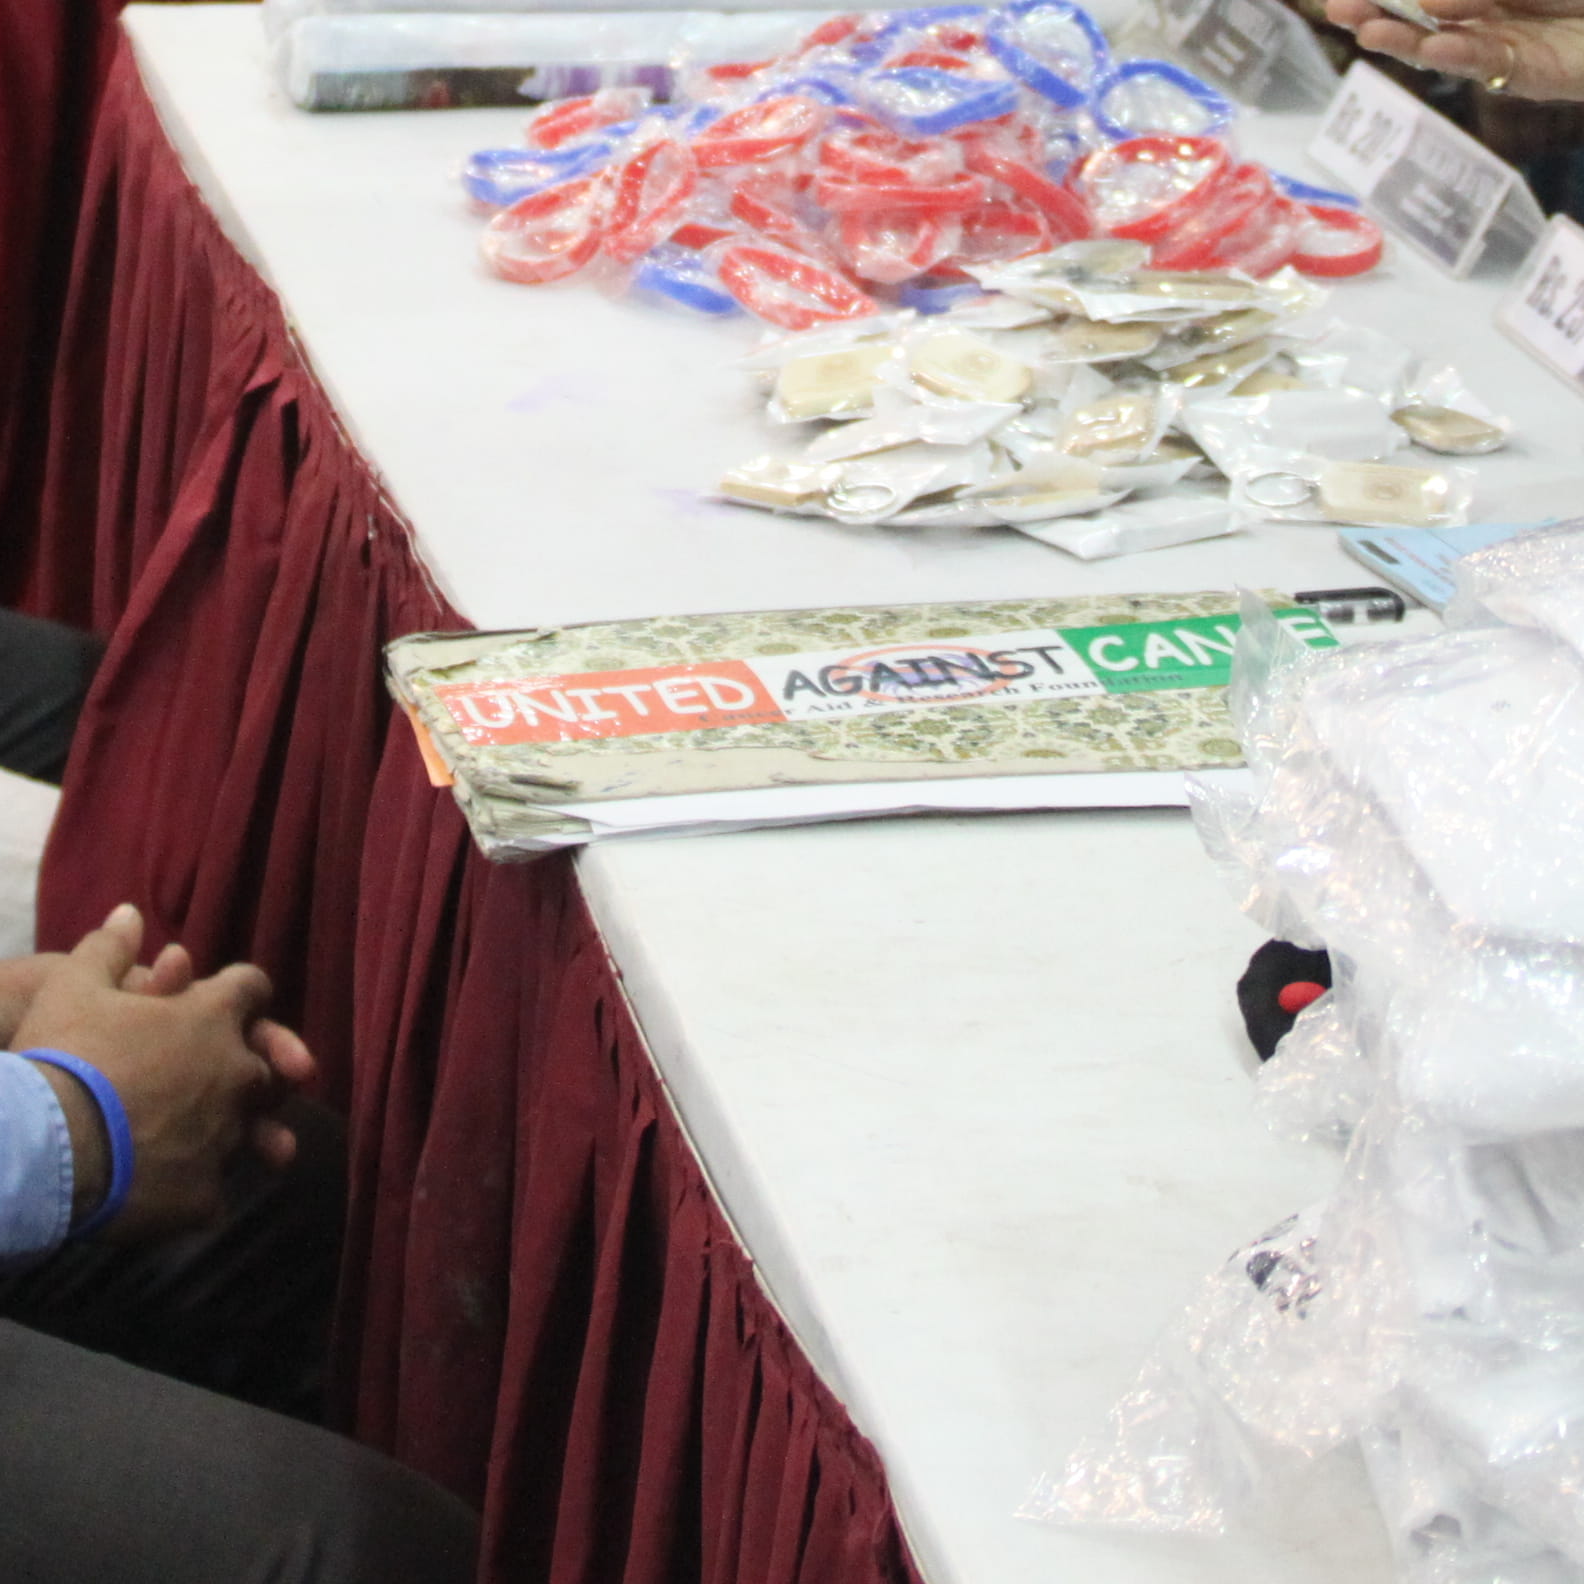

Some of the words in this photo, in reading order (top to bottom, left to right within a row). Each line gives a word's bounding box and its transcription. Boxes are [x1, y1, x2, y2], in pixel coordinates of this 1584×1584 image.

[456, 674, 757, 732] UNITED
[782, 644, 1067, 703] AGAINST
[804, 700, 854, 715] Aid
[862, 698, 884, 710] &
